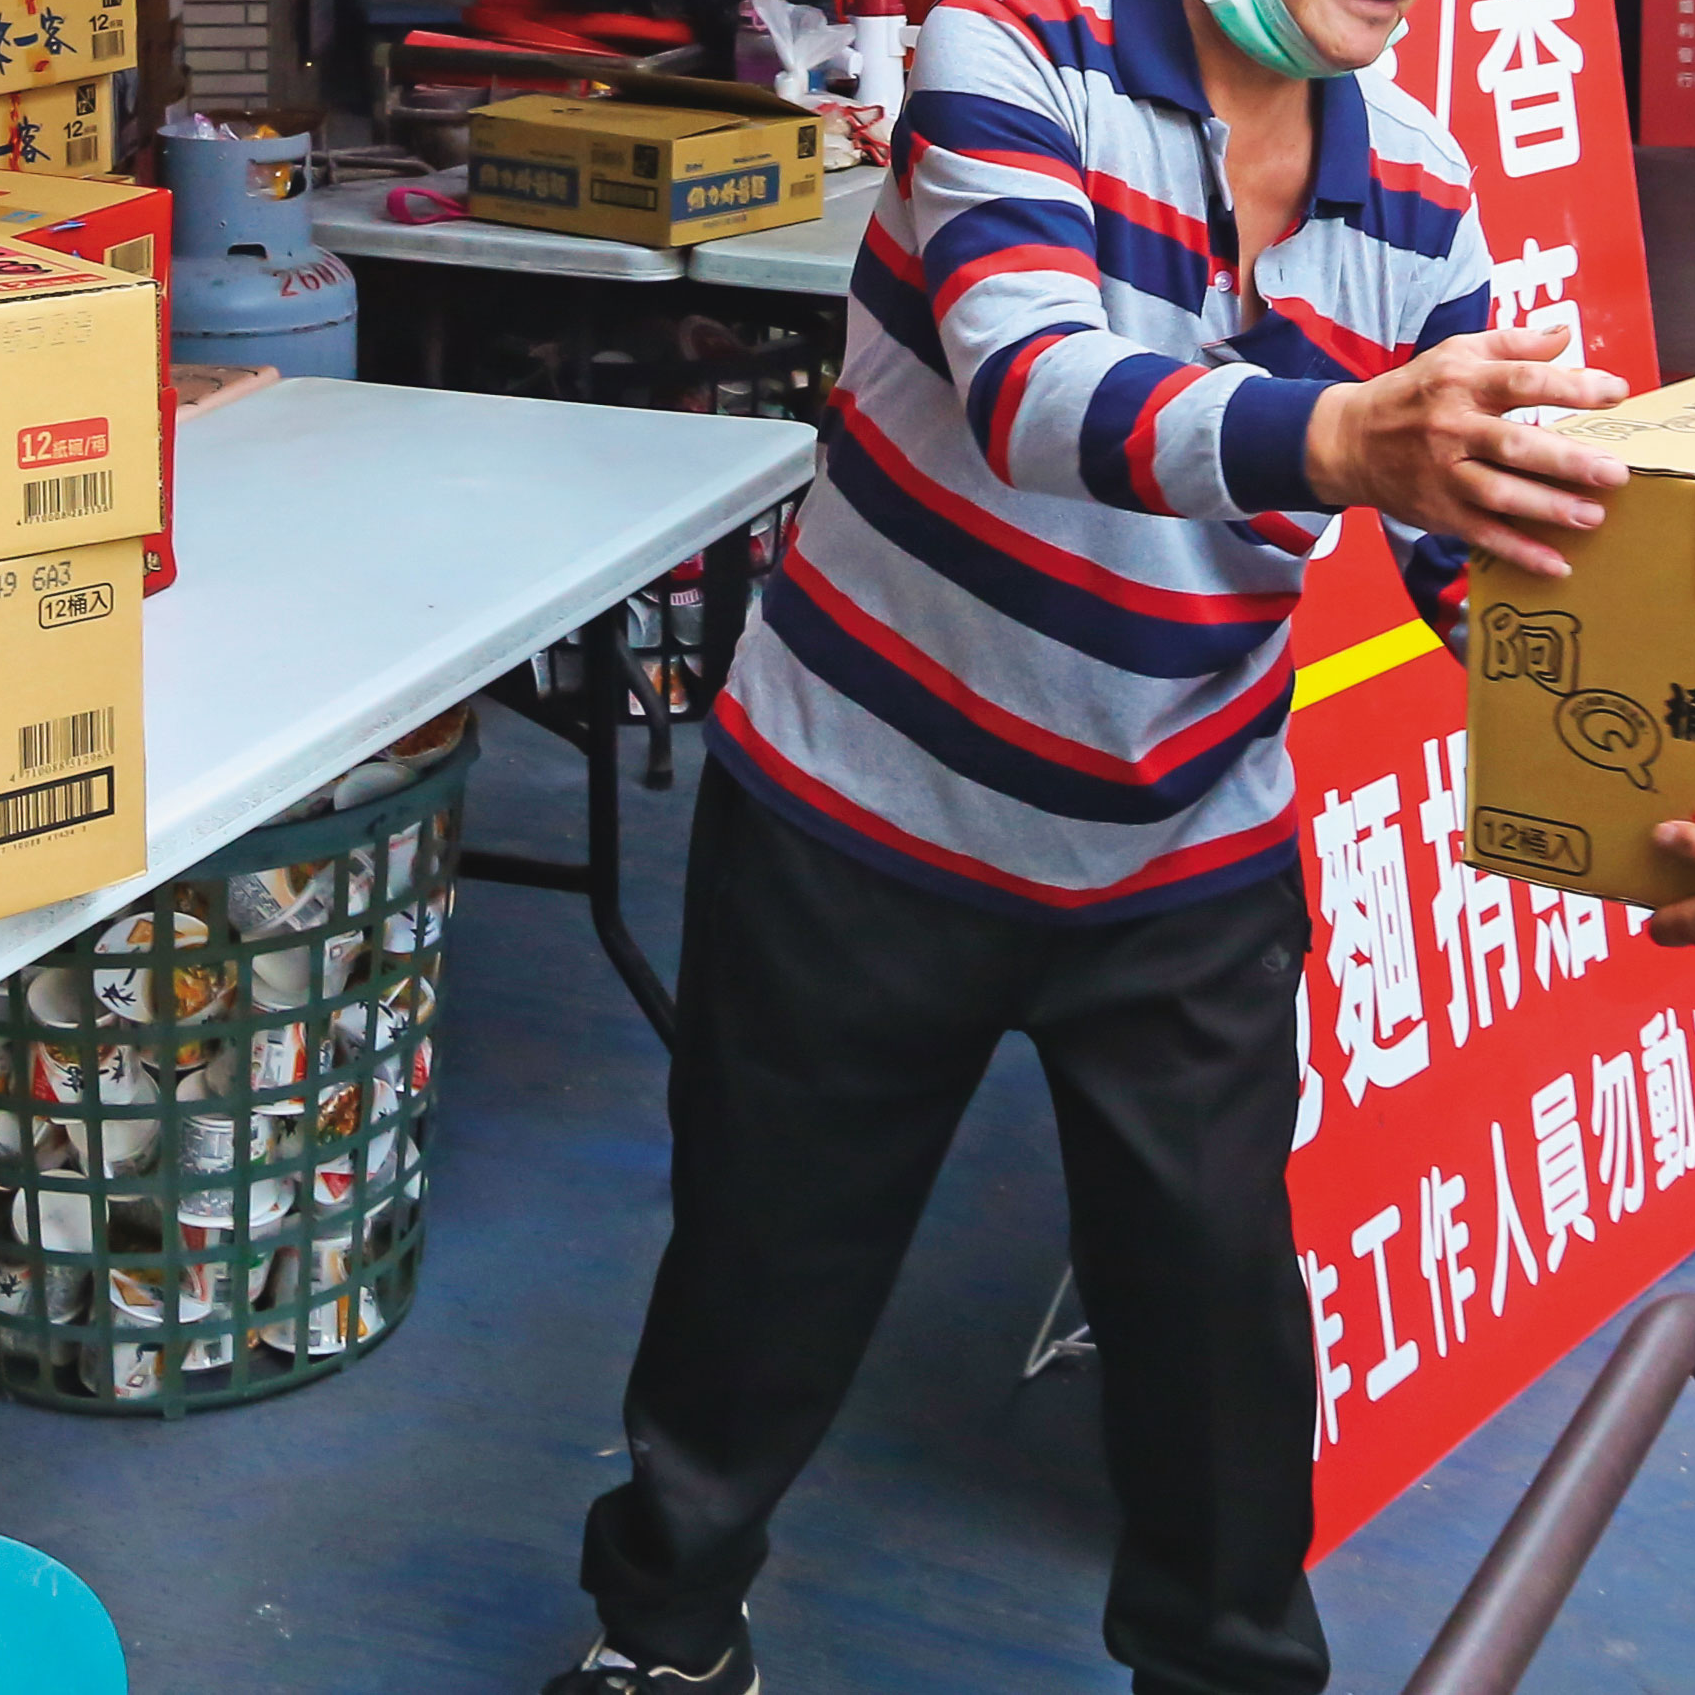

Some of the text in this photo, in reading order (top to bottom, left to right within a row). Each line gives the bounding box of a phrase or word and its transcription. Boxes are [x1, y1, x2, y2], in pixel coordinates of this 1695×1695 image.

[32, 559, 72, 593] 6A3
[44, 589, 109, 621] 12桶入
[1482, 602, 1663, 793] 阿Q
[1482, 817, 1581, 867] 12桶入
